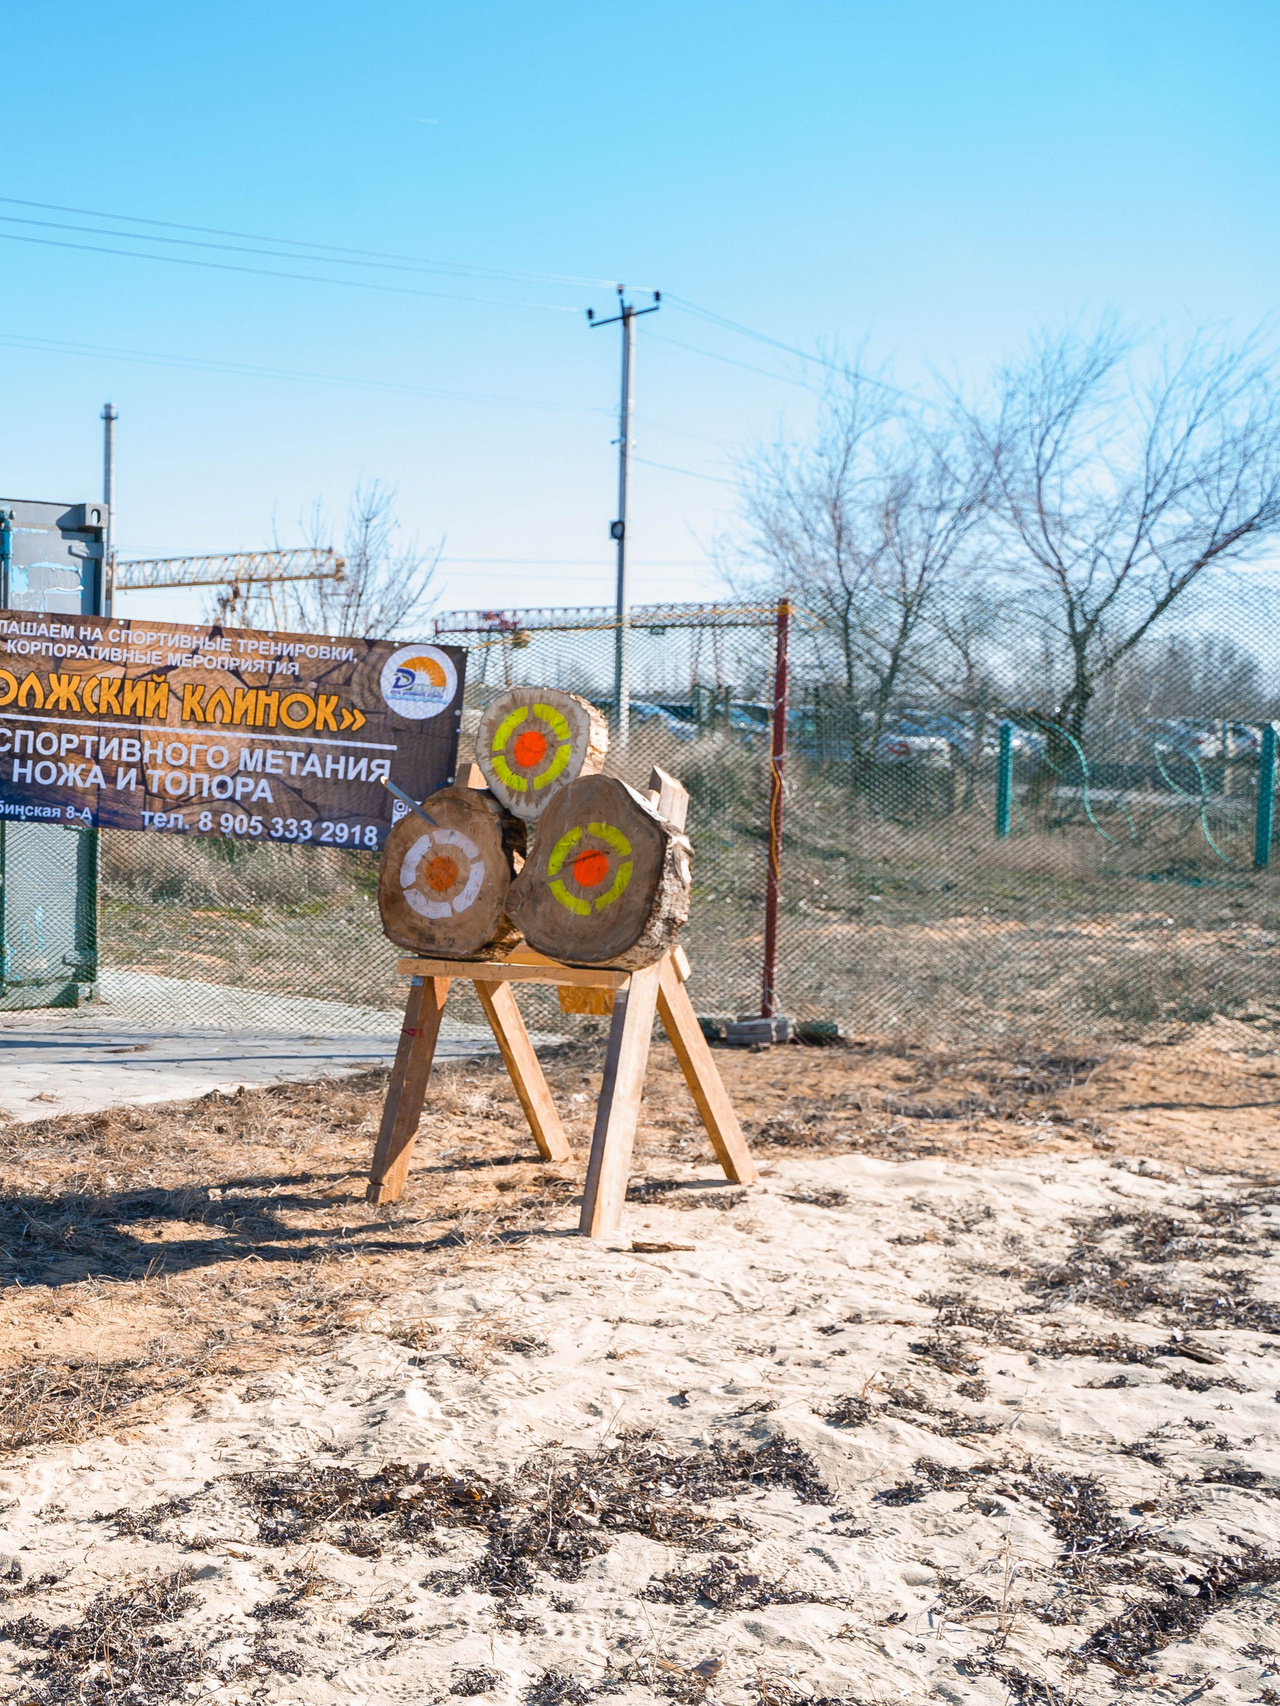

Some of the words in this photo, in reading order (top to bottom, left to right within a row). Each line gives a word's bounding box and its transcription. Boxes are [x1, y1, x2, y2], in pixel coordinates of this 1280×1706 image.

[6, 640, 162, 665] КОРПОРАТИВНЫЕ
[167, 653, 299, 676] МЕРОПРИЯТИЯ
[79, 627, 103, 641] НА
[108, 629, 232, 653] СПОРТИВНЫЕ
[238, 639, 358, 664] ТРЕНИРОВКИ,
[181, 683, 367, 732] КЛИНОК»
[12, 758, 107, 790] НОЖА
[116, 767, 137, 792] И
[147, 769, 274, 804] ТОПОРА
[239, 748, 391, 783] МЕТАНИЯ
[65, 806, 93, 821] 8-А
[141, 810, 190, 830] тел.
[199, 811, 213, 832] 8
[219, 813, 264, 836] 905
[270, 817, 313, 840] 333
[320, 822, 378, 847] 2918
